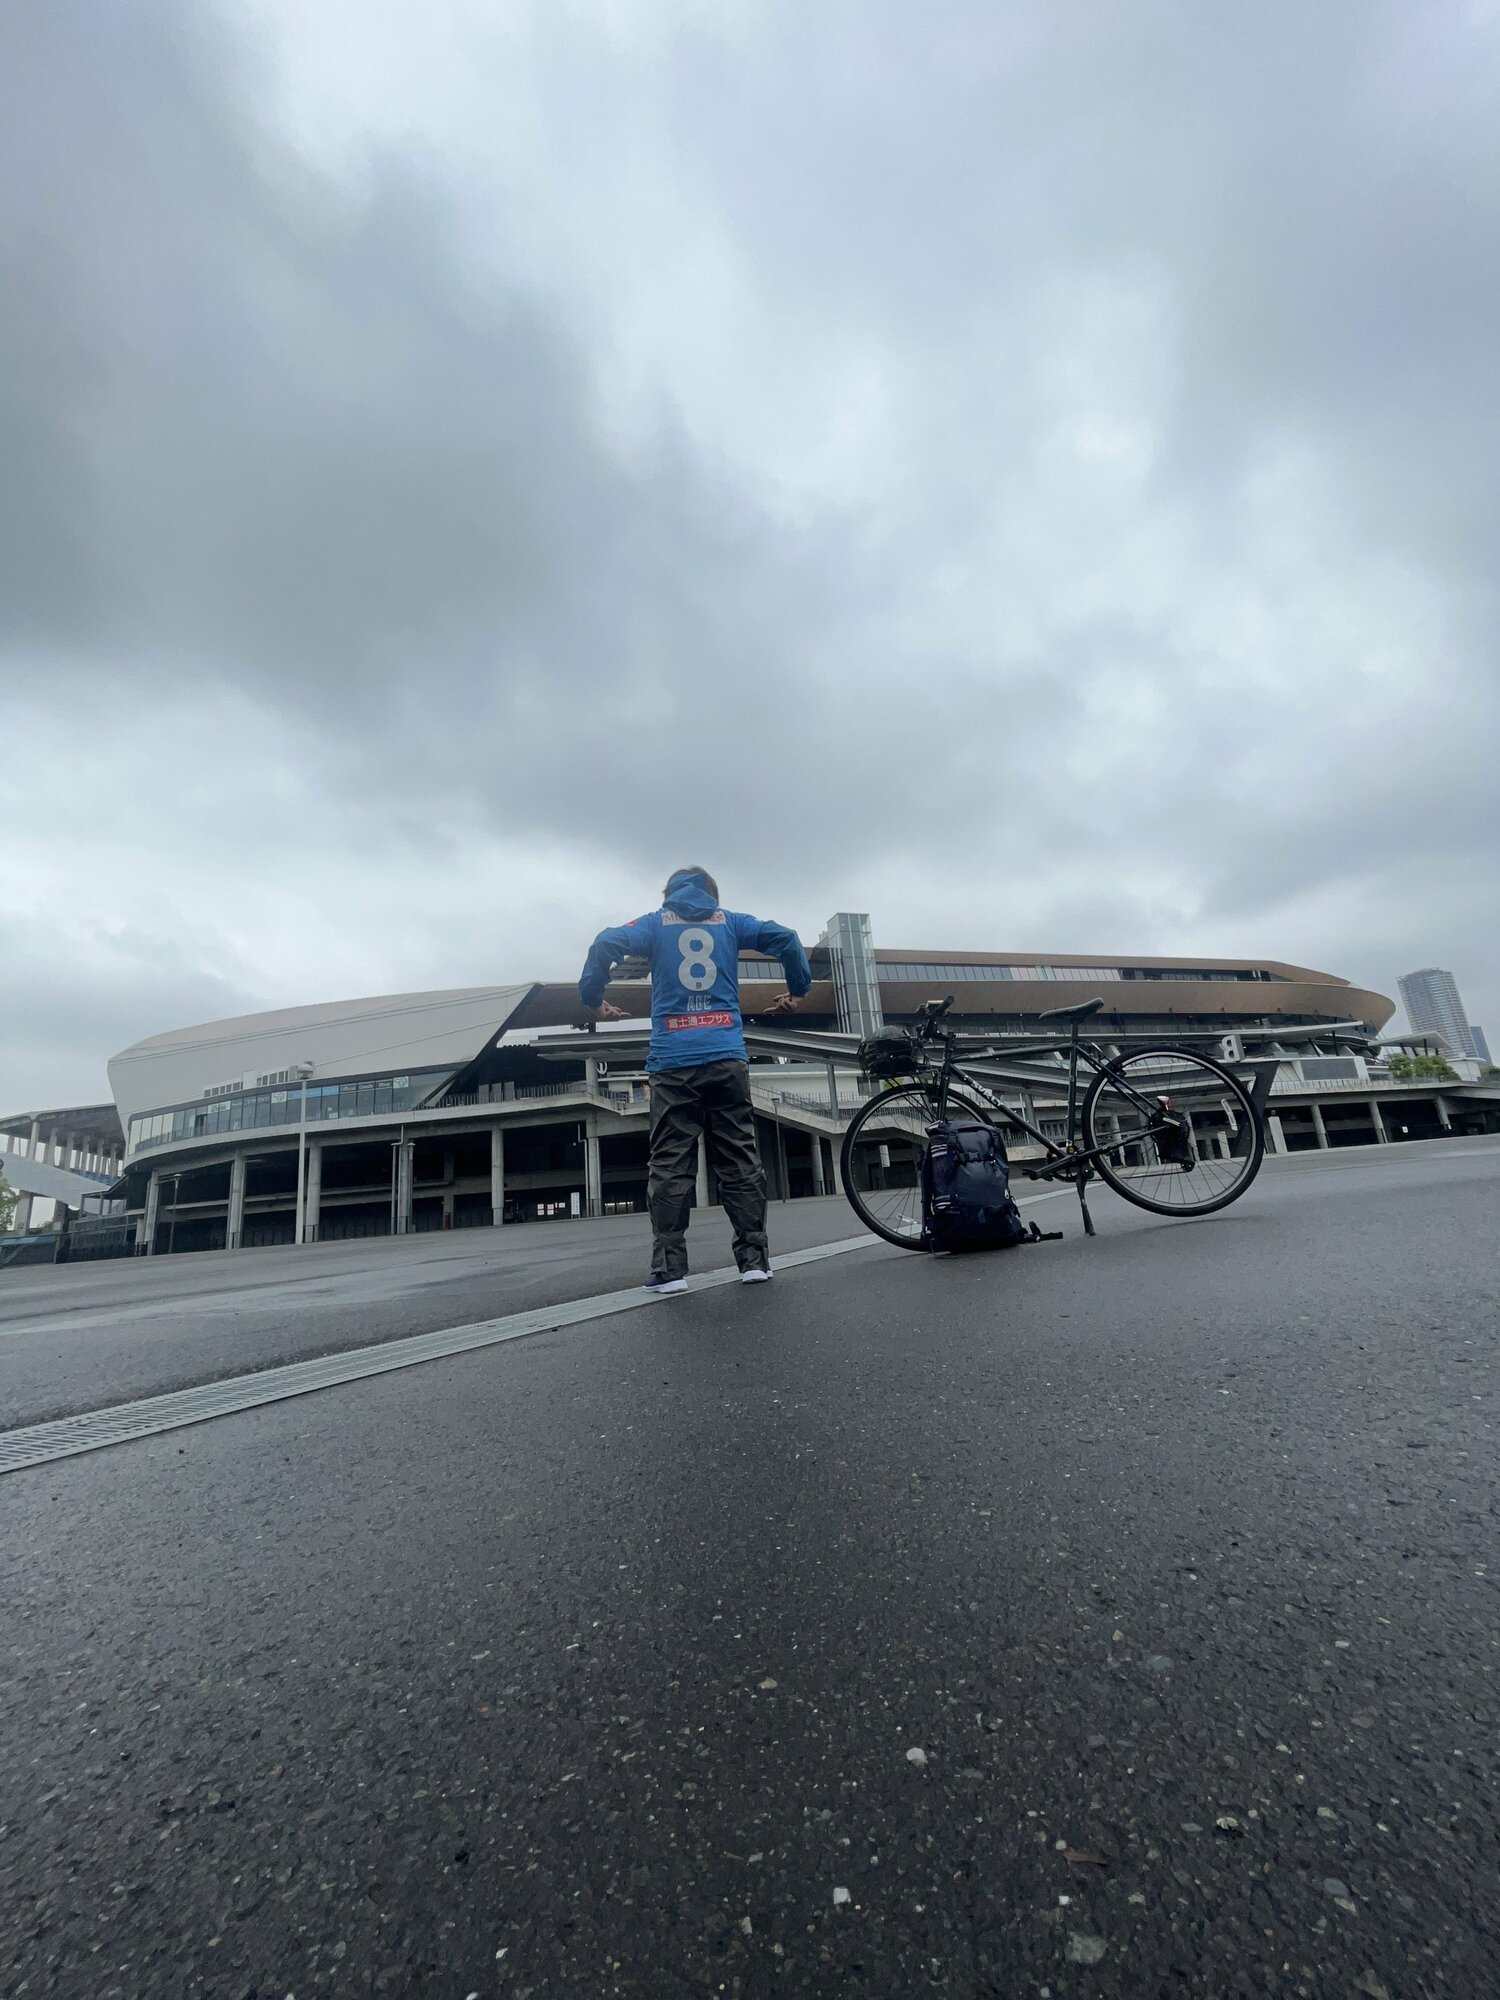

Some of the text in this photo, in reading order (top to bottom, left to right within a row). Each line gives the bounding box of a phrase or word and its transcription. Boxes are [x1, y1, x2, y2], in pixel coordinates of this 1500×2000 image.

[678, 927, 718, 992] 8
[668, 1014, 731, 1029] 富士通エフサス
